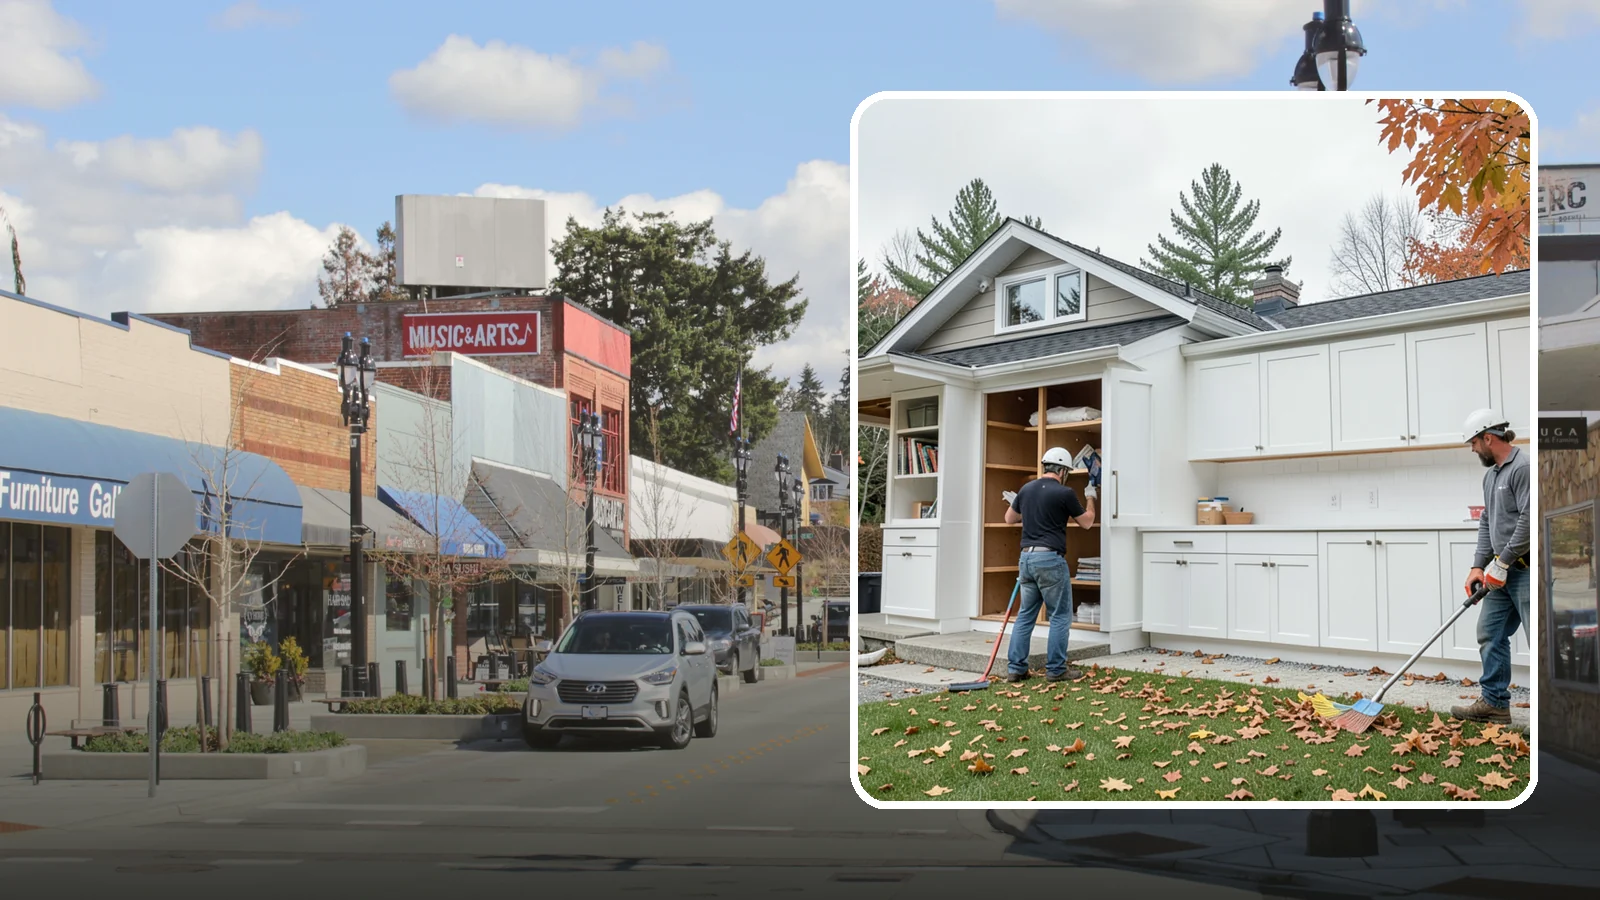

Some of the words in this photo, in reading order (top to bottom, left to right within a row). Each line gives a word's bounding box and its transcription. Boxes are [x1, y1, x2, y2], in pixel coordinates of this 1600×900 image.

[0, 471, 79, 515] Furniture
[90, 482, 121, 519] Gal
[453, 563, 479, 574] SUSHI
